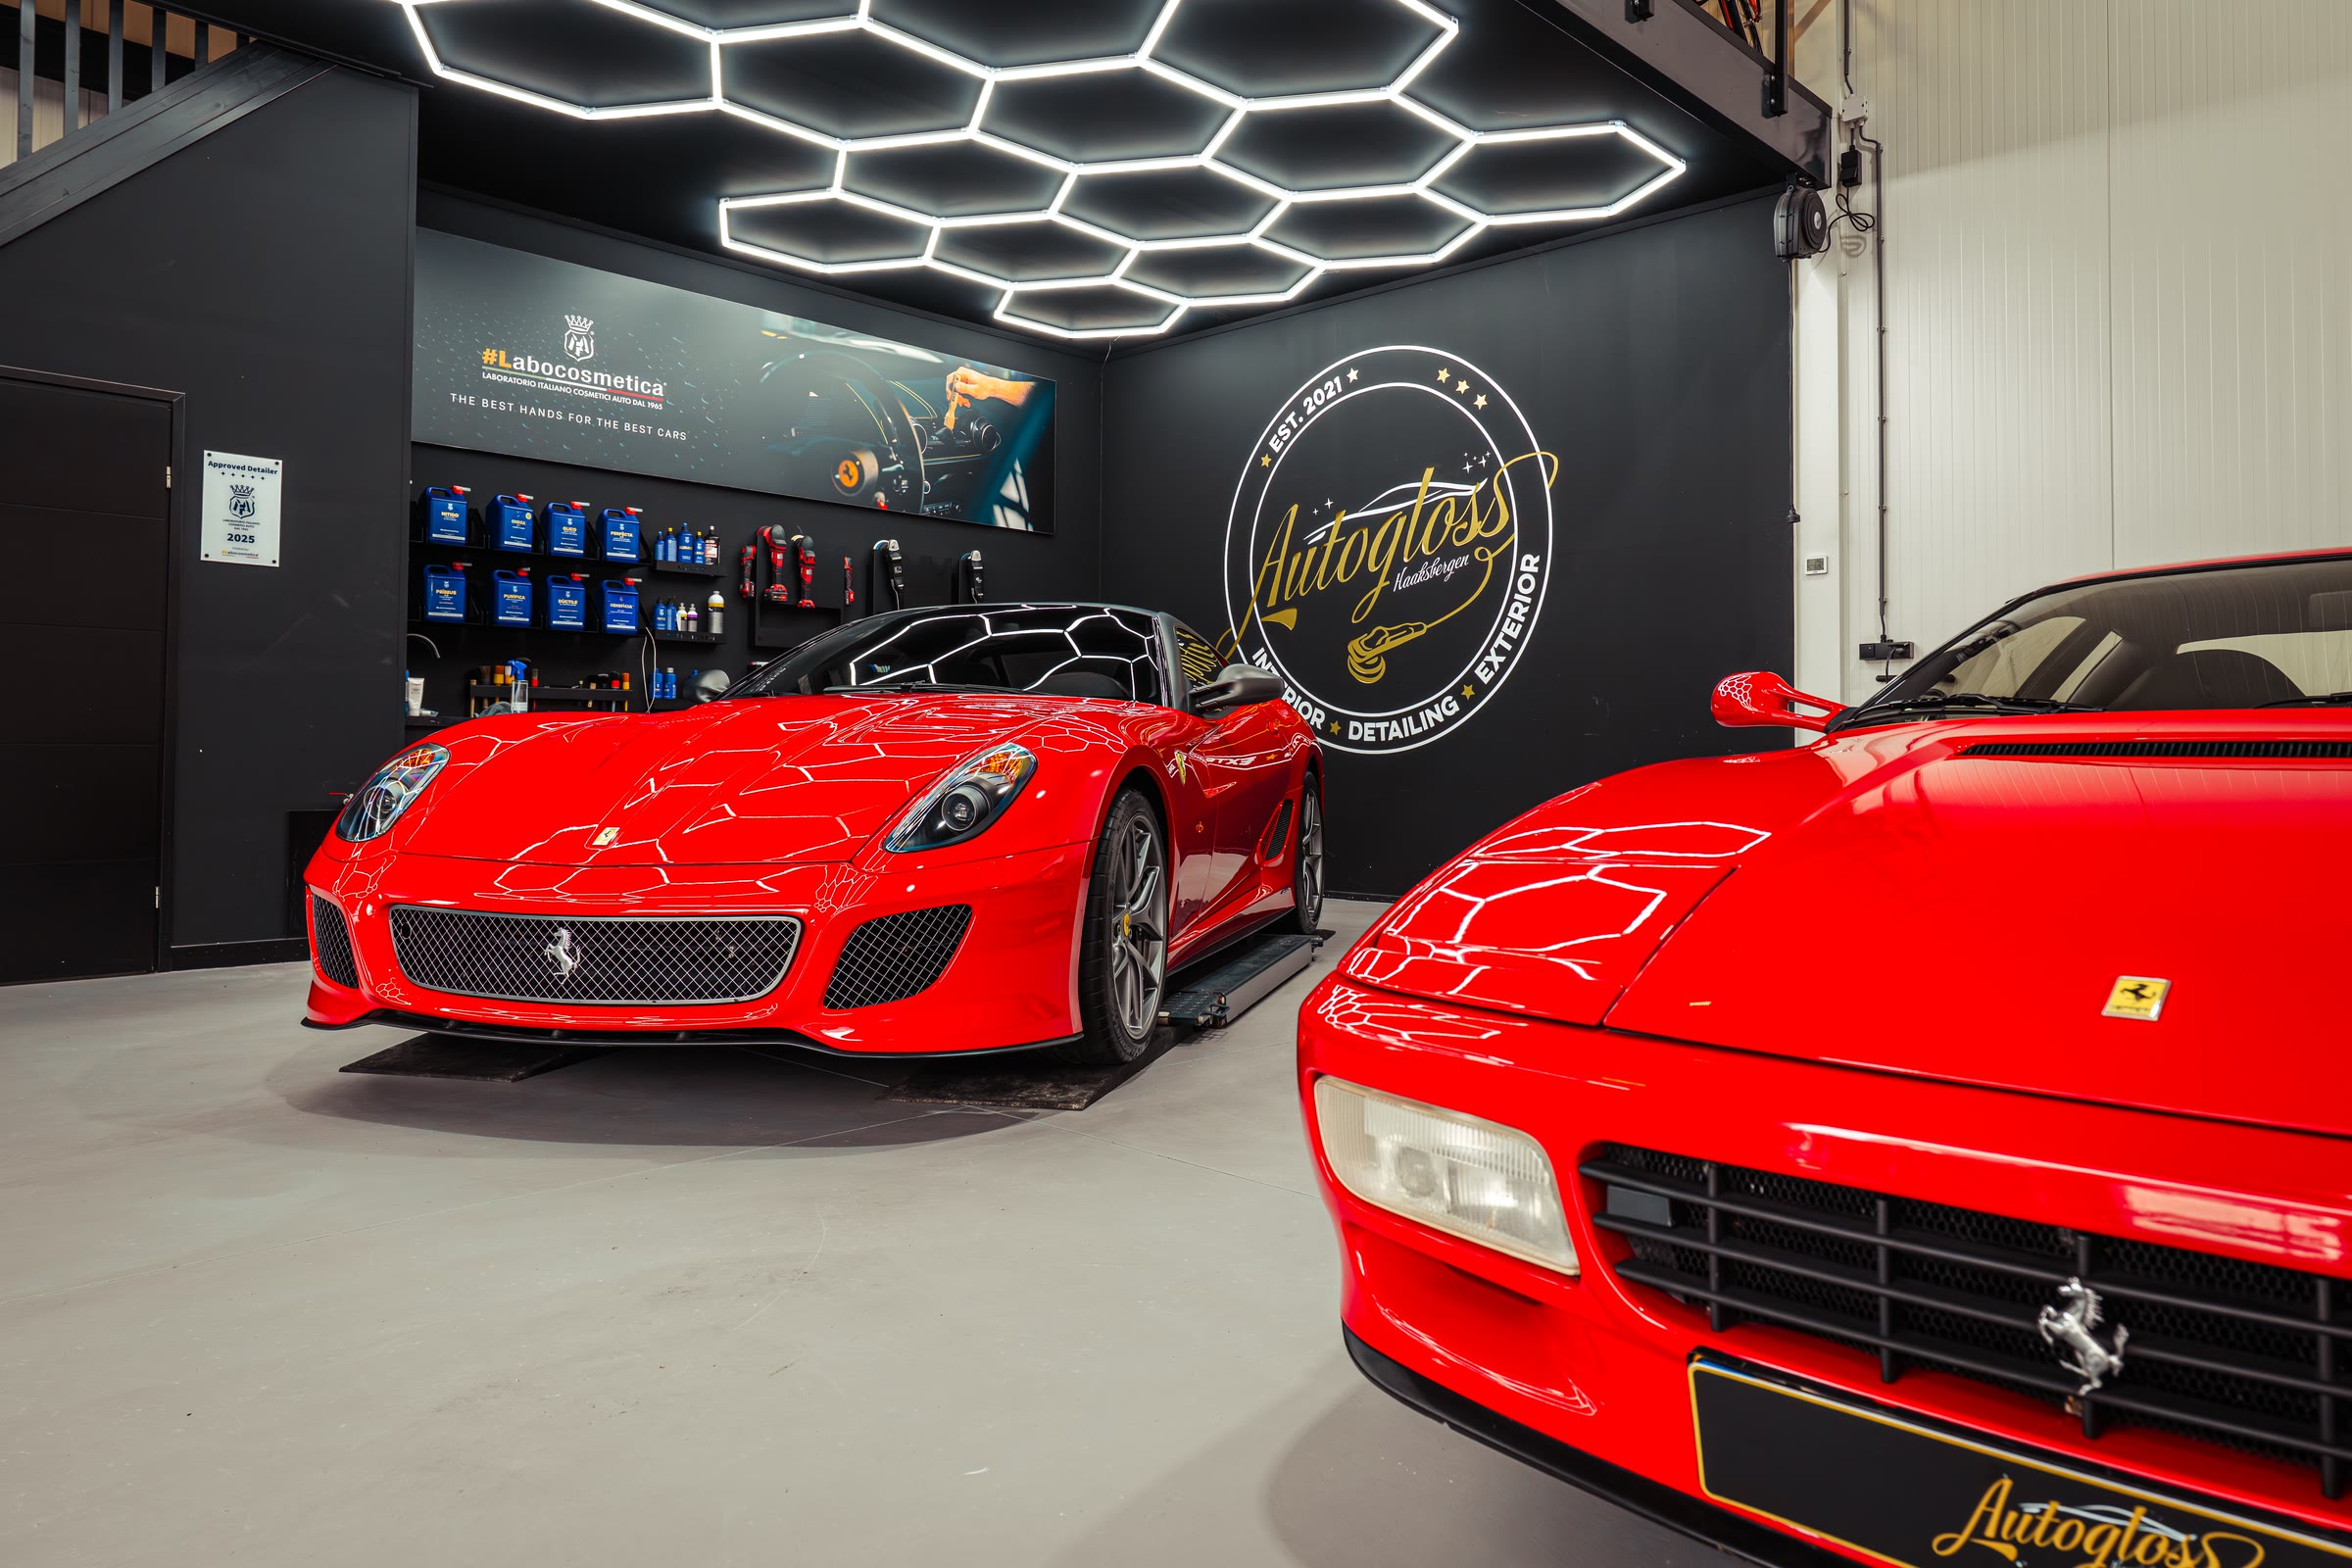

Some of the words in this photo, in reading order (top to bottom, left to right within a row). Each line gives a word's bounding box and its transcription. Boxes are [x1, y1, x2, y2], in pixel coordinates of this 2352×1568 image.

[481, 347, 664, 397] #Labocosmetica
[482, 371, 536, 387] LABORATORIO
[537, 382, 572, 394] ITALIANO
[573, 388, 612, 401] COSMETICI
[612, 395, 632, 405] AUTO
[632, 399, 646, 408] DAL
[648, 402, 663, 411] 1965
[450, 392, 475, 406] THE
[481, 398, 514, 412] BEST
[519, 405, 563, 420] HANDS
[568, 413, 591, 425] FOR
[597, 417, 618, 429] THE
[624, 422, 653, 435] BEST
[657, 427, 686, 441] CARS
[1268, 411, 1303, 453] EST.
[1302, 375, 1343, 416] 2021
[208, 461, 245, 470] Approved
[247, 466, 278, 474] Detailer
[226, 533, 255, 543] 2025
[1252, 466, 1514, 632] Autogloss
[1393, 554, 1469, 592] Haaksbergen
[1251, 647, 1326, 730] INRIOR
[1348, 695, 1460, 742] DETAILING
[1474, 554, 1541, 685] EXTERIOR
